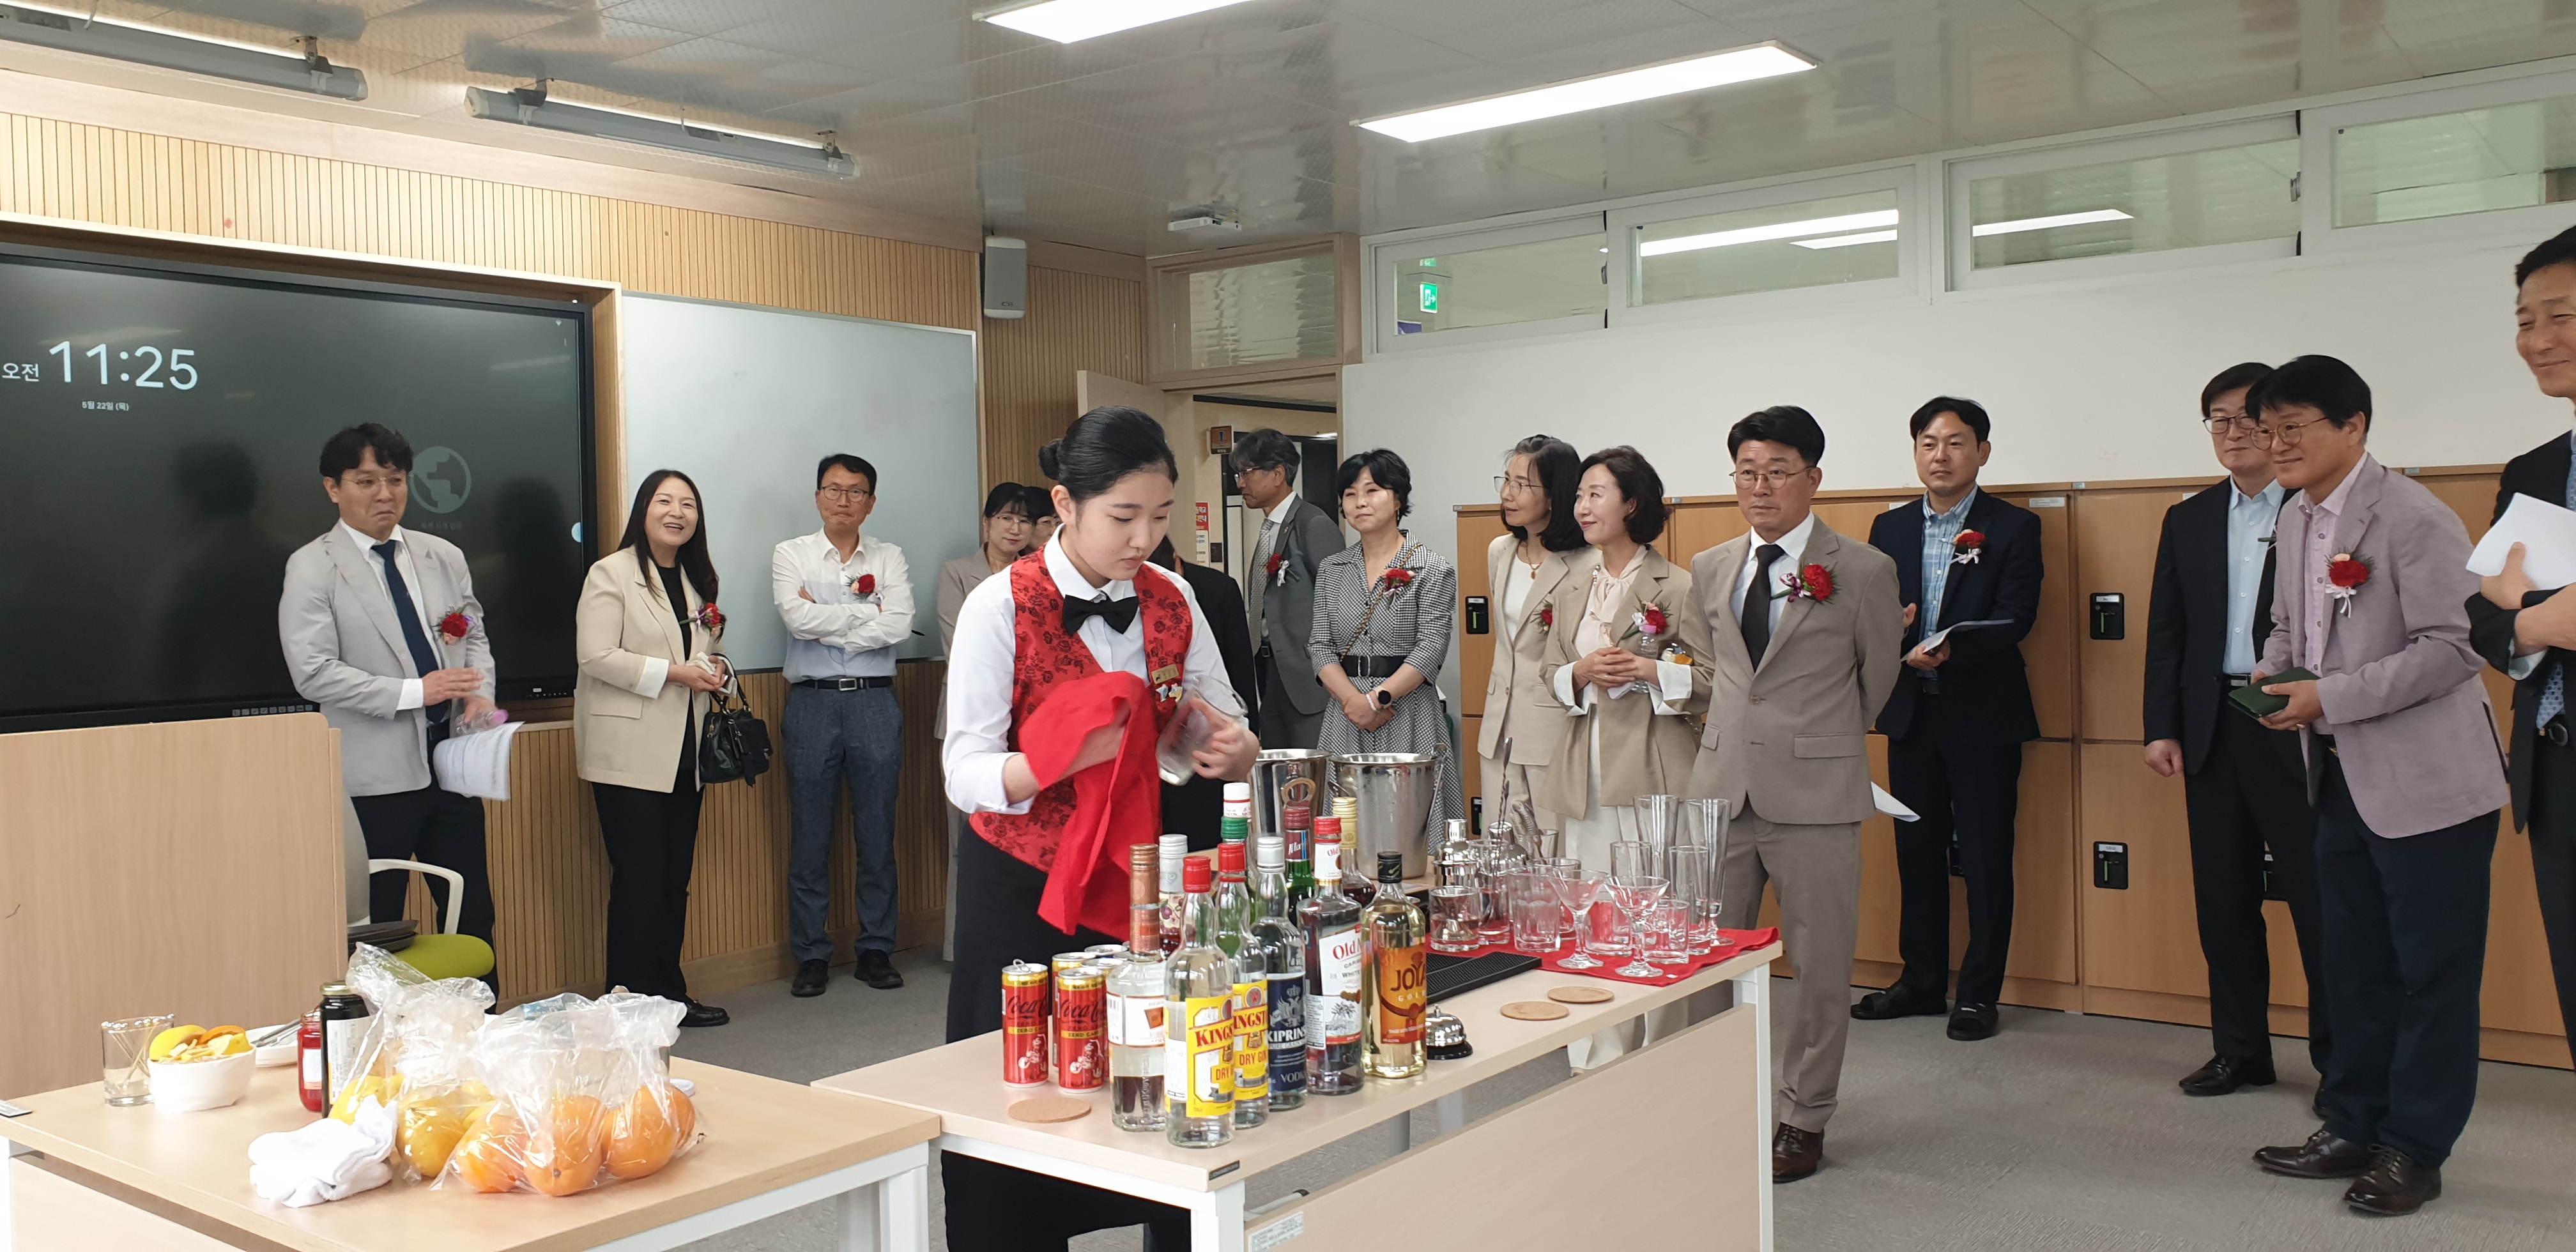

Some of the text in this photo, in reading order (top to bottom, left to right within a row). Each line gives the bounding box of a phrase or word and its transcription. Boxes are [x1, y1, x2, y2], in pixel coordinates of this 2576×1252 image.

[2, 341, 198, 390] 오전 11:25
[96, 402, 114, 411] 22일
[1333, 940, 1355, 960] Old
[1342, 970, 1360, 979] WHITE
[1239, 1053, 1256, 1065] DRY
[1216, 1067, 1230, 1081] DRY
